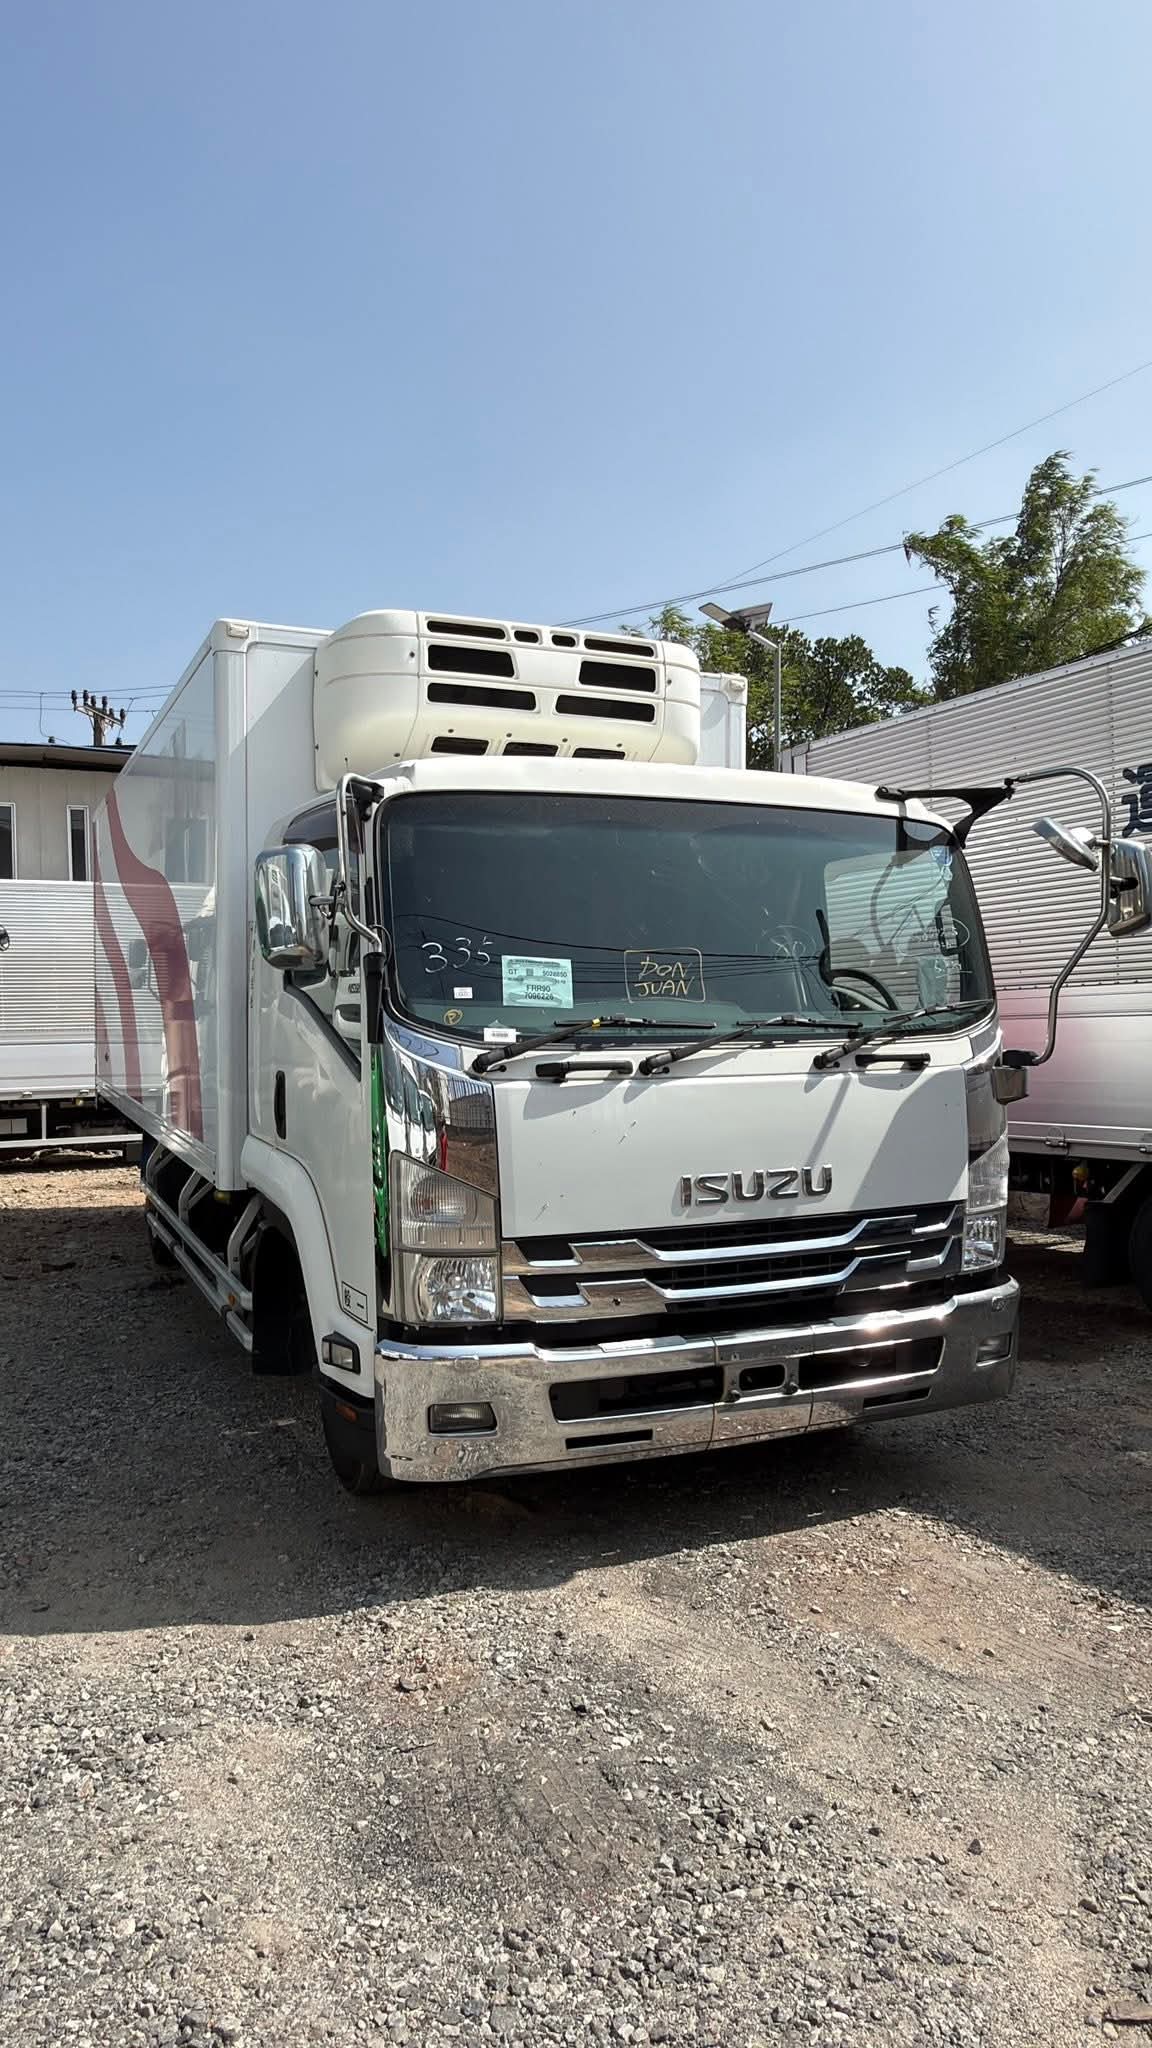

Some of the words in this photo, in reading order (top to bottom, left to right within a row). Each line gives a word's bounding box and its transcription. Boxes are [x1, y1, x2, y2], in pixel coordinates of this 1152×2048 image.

[638, 956, 693, 980] DON
[526, 984, 552, 993] FRR90
[634, 976, 696, 997] JUAN
[680, 1164, 833, 1208] ISUZU
